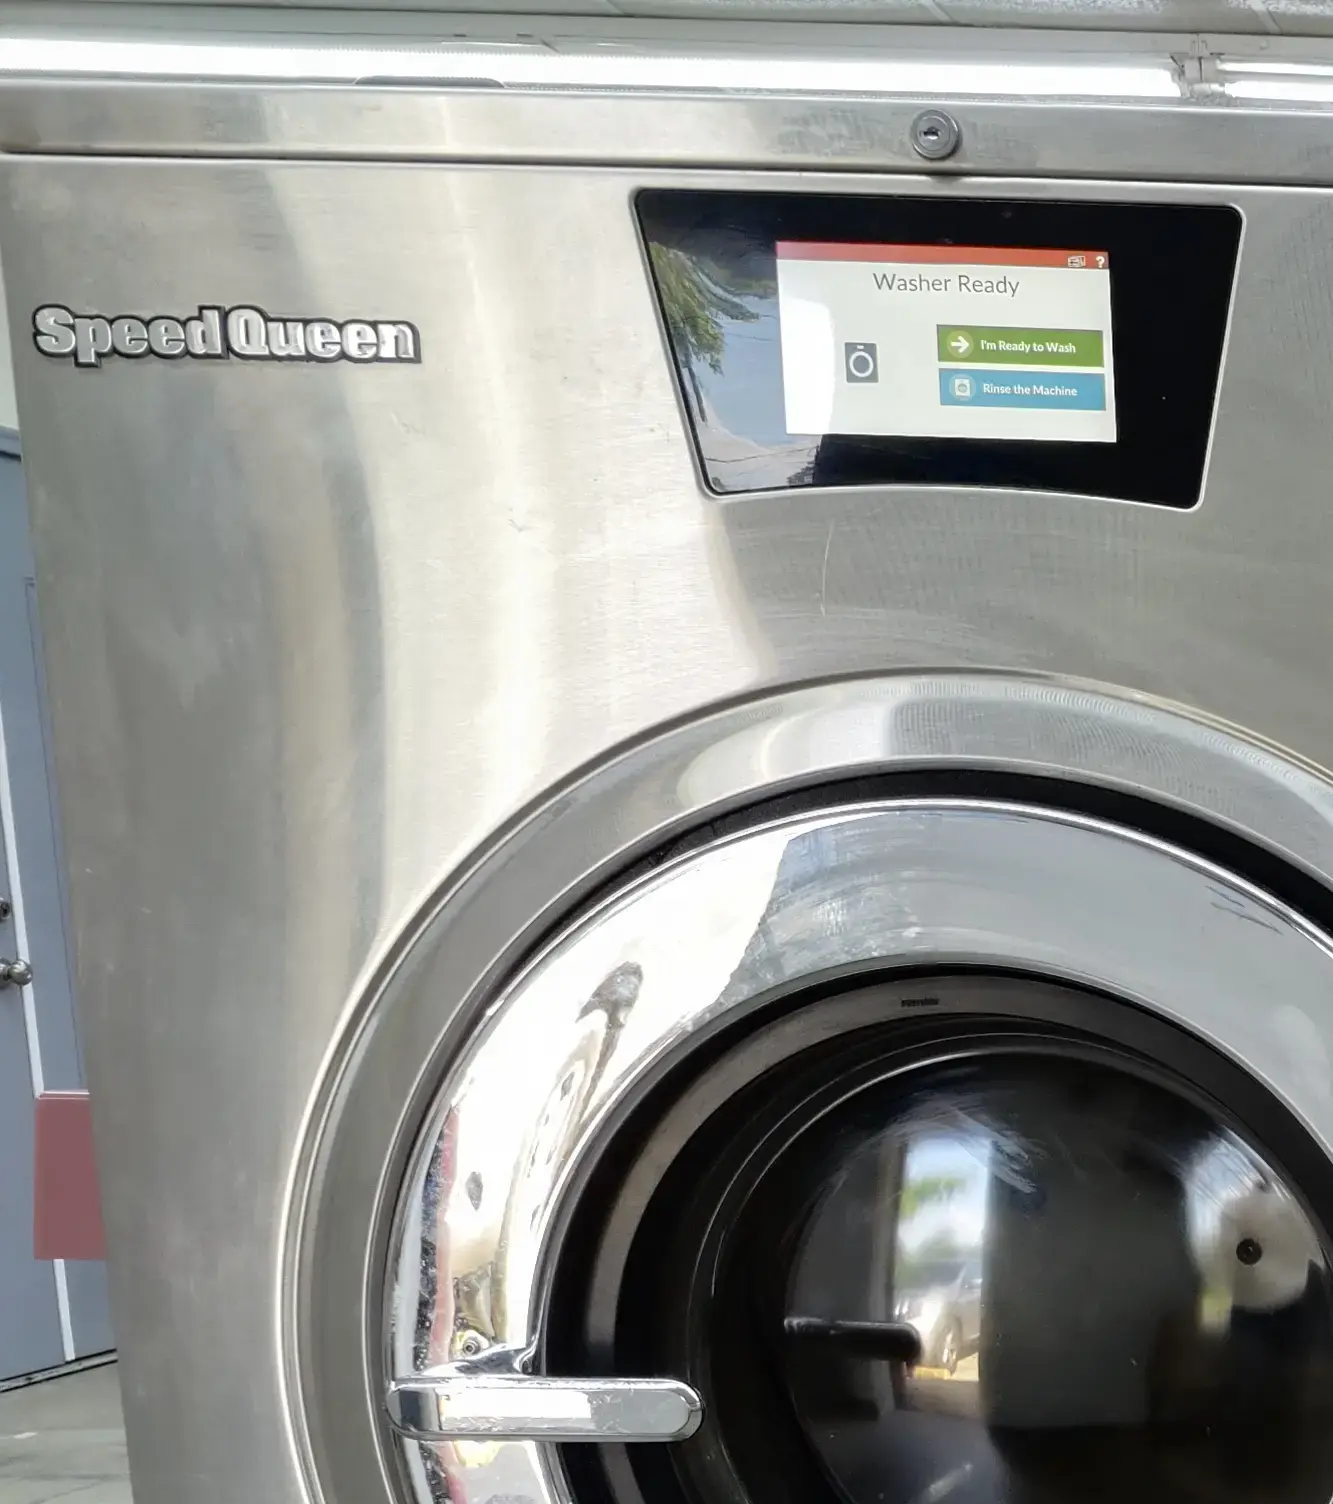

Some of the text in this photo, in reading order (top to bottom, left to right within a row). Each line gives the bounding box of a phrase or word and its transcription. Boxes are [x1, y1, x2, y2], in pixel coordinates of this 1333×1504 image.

[1095, 256, 1105, 268] ?
[873, 273, 1019, 297] Washer Ready
[34, 304, 421, 367] Speed Queen
[981, 340, 1076, 353] I'm Ready to Wash
[983, 383, 1078, 396] Rinse the Machine
